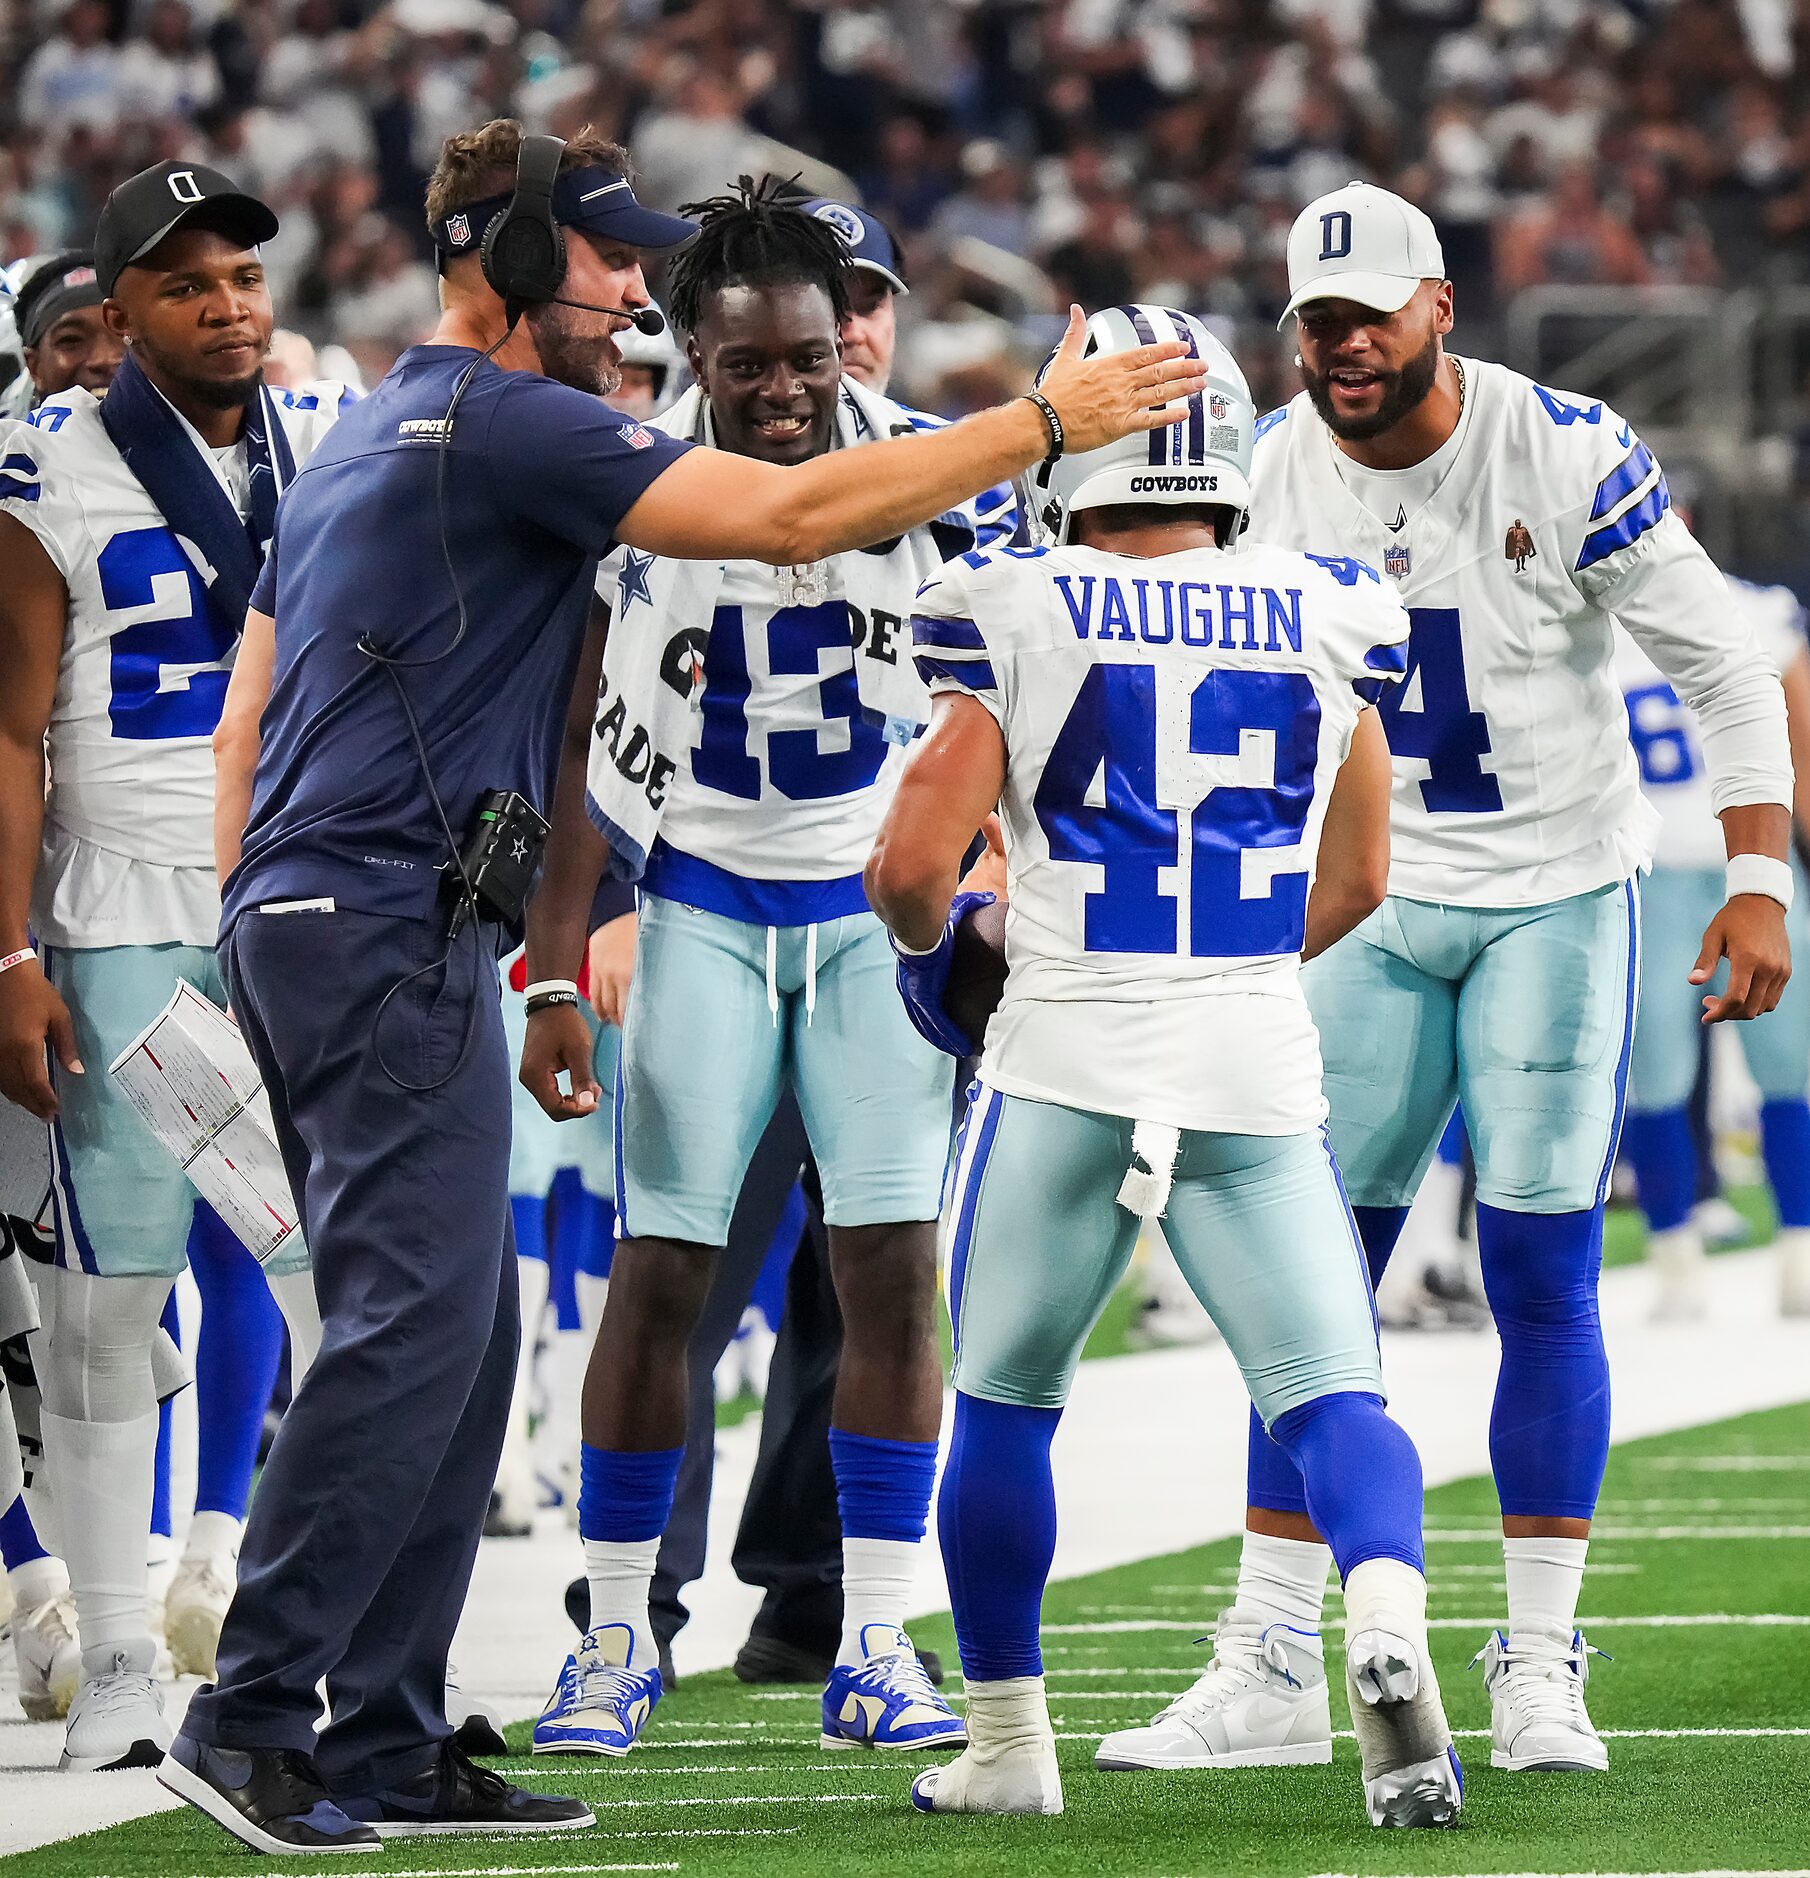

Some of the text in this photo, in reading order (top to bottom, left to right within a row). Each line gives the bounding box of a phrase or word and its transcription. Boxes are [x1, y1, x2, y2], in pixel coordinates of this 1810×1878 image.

[1318, 210, 1352, 262] D
[1032, 392, 1062, 443] THE STORM
[1212, 404, 1226, 417] NFL
[1130, 476, 1218, 493] COWBOYS
[1388, 559, 1407, 573] NFL
[1054, 575, 1303, 654] VAUGHN
[690, 600, 891, 802] 13
[1376, 606, 1505, 814] 4
[1032, 663, 1323, 958] 42
[364, 855, 417, 871] DRI-FIT
